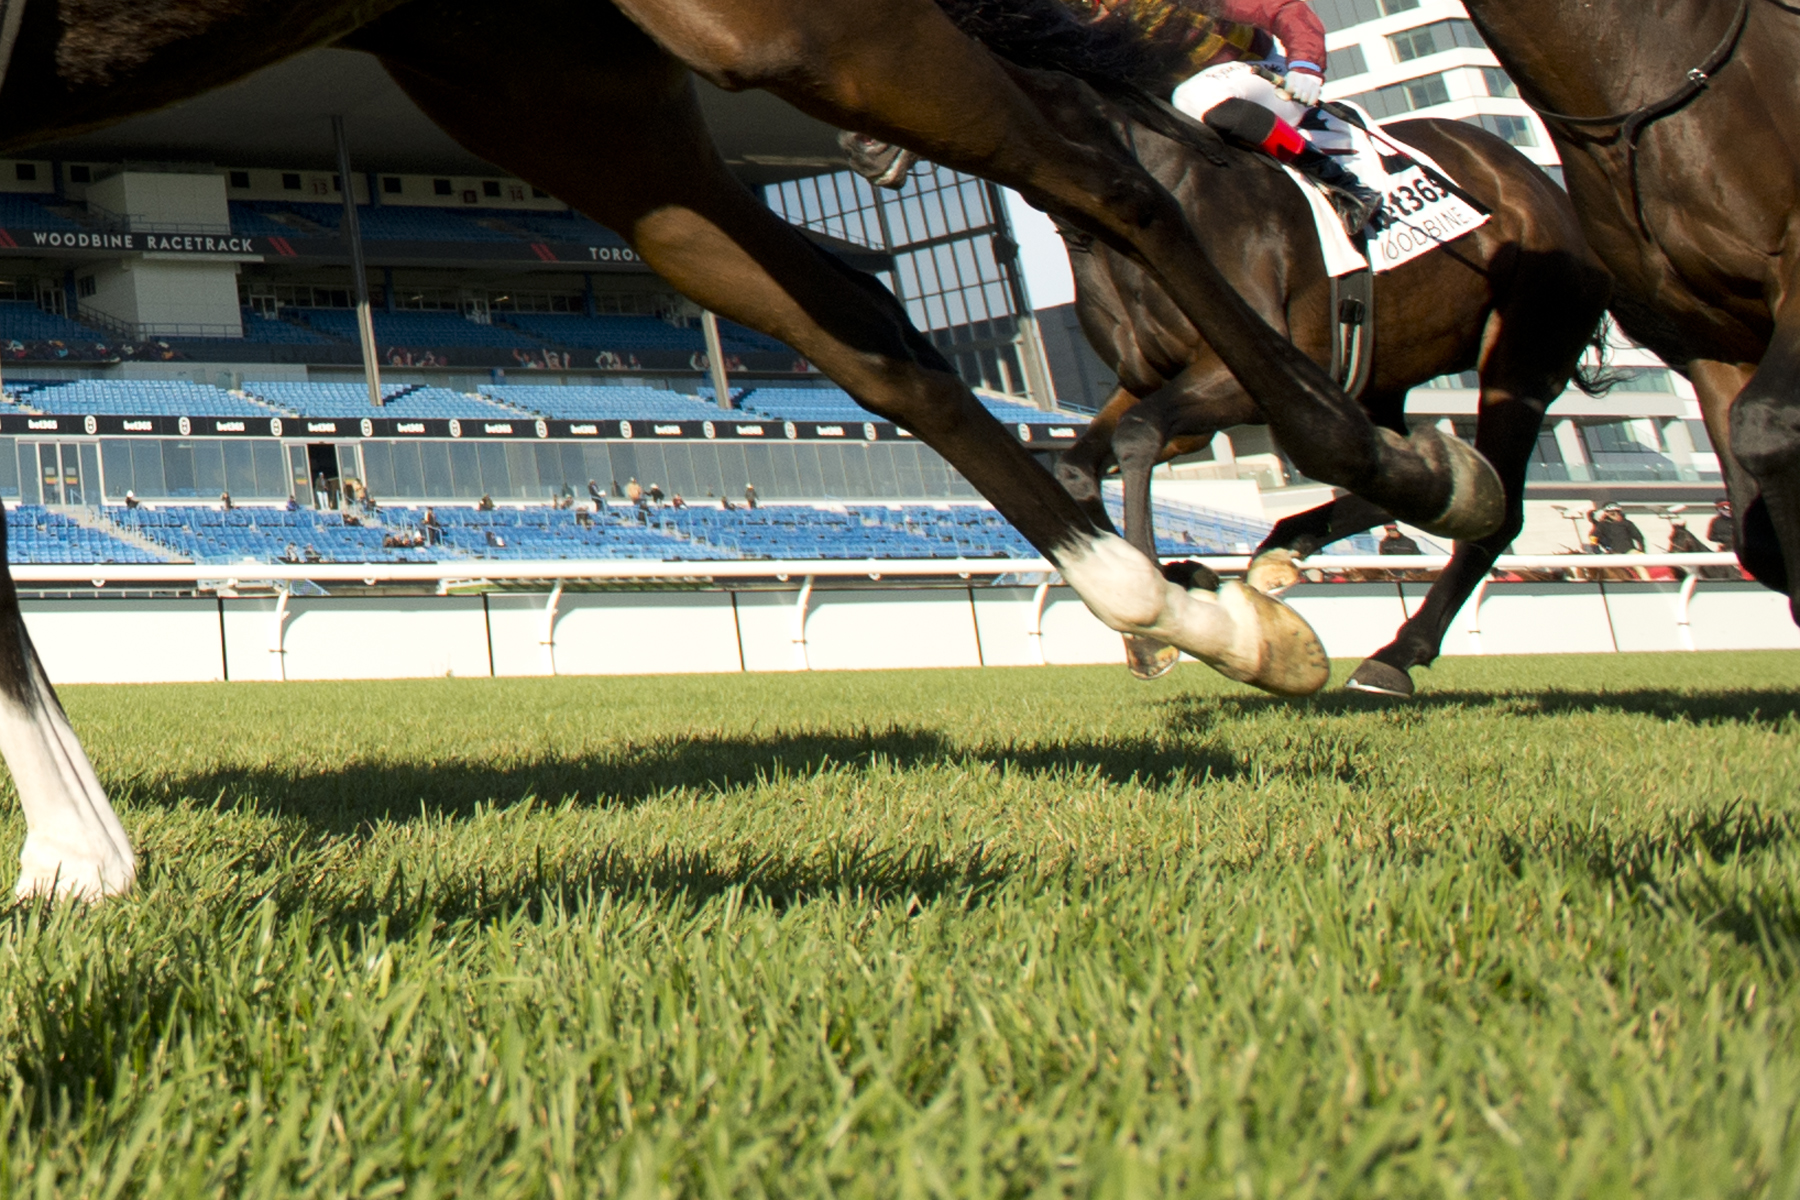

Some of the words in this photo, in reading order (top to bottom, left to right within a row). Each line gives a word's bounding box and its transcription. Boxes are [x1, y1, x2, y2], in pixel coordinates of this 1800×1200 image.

[33, 231, 134, 249] WOODBINE
[146, 235, 254, 253] RACETRACK
[588, 246, 640, 261] TORO
